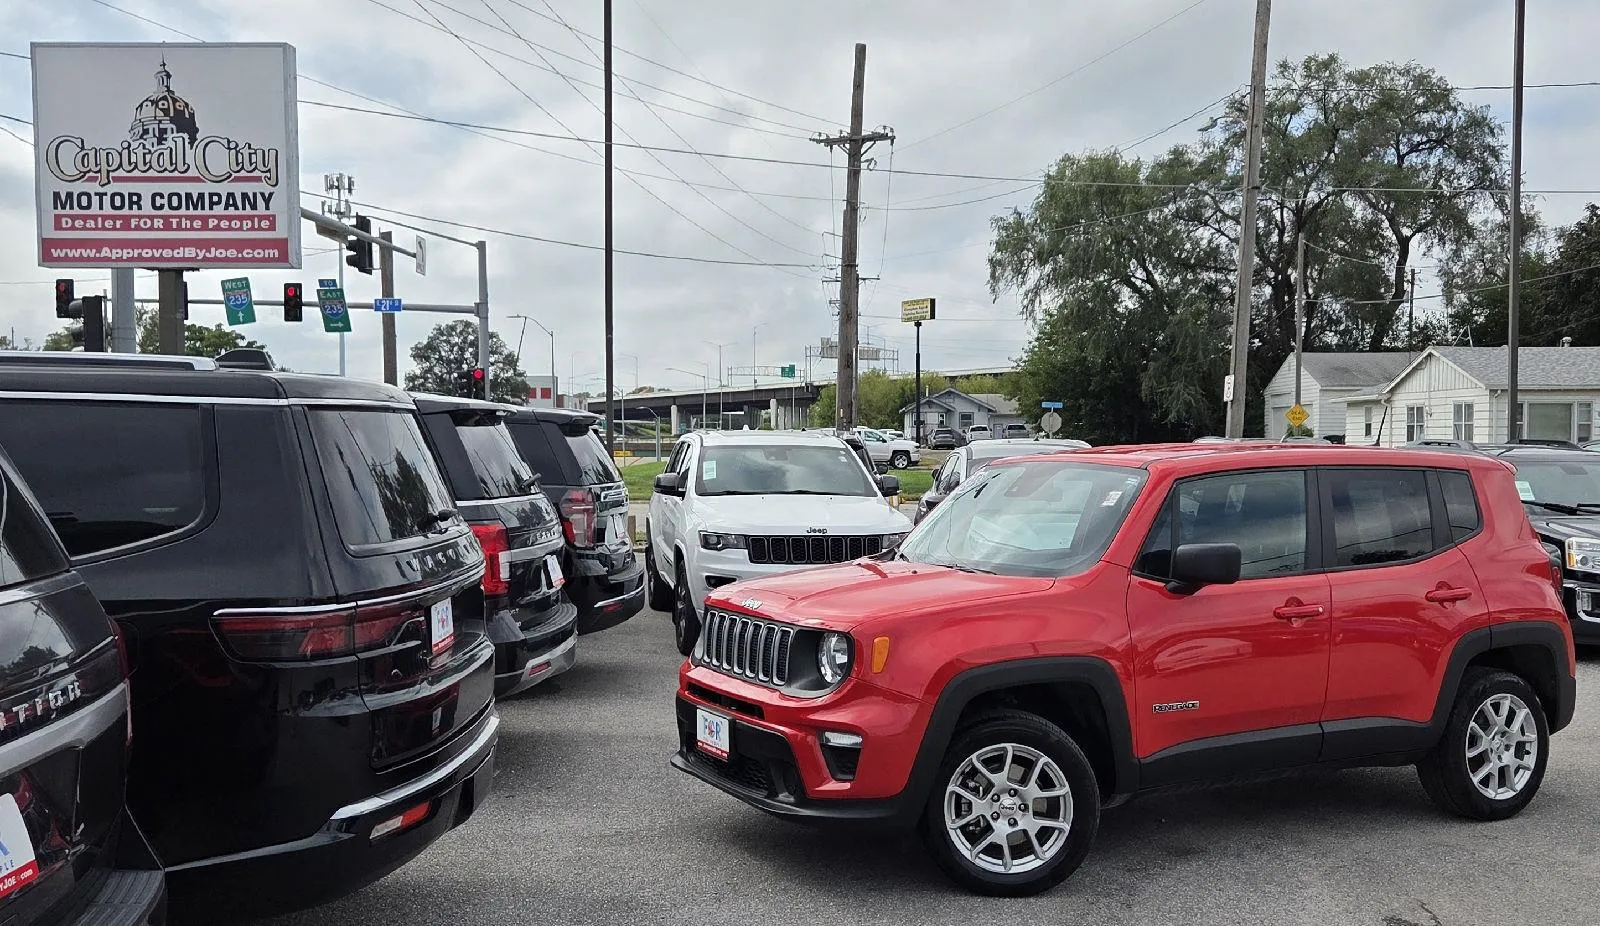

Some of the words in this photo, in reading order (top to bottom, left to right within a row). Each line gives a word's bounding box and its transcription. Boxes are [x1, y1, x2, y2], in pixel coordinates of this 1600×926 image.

[46, 135, 190, 187] Capital
[194, 135, 279, 187] City
[53, 191, 143, 211] MOTOR
[151, 191, 275, 211] COMPANY
[61, 218, 123, 229] Dealer
[130, 218, 164, 229] FOR
[170, 218, 203, 229] The
[208, 218, 271, 231] People
[50, 246, 279, 260] www.ApprovedByJoe.com
[223, 280, 247, 290] WEST
[228, 293, 247, 305] 235
[320, 291, 341, 299] EAST
[324, 303, 344, 314] 235
[806, 526, 828, 535] Jeep
[741, 597, 764, 610] Jeep
[1152, 701, 1200, 713] RENEGADE
